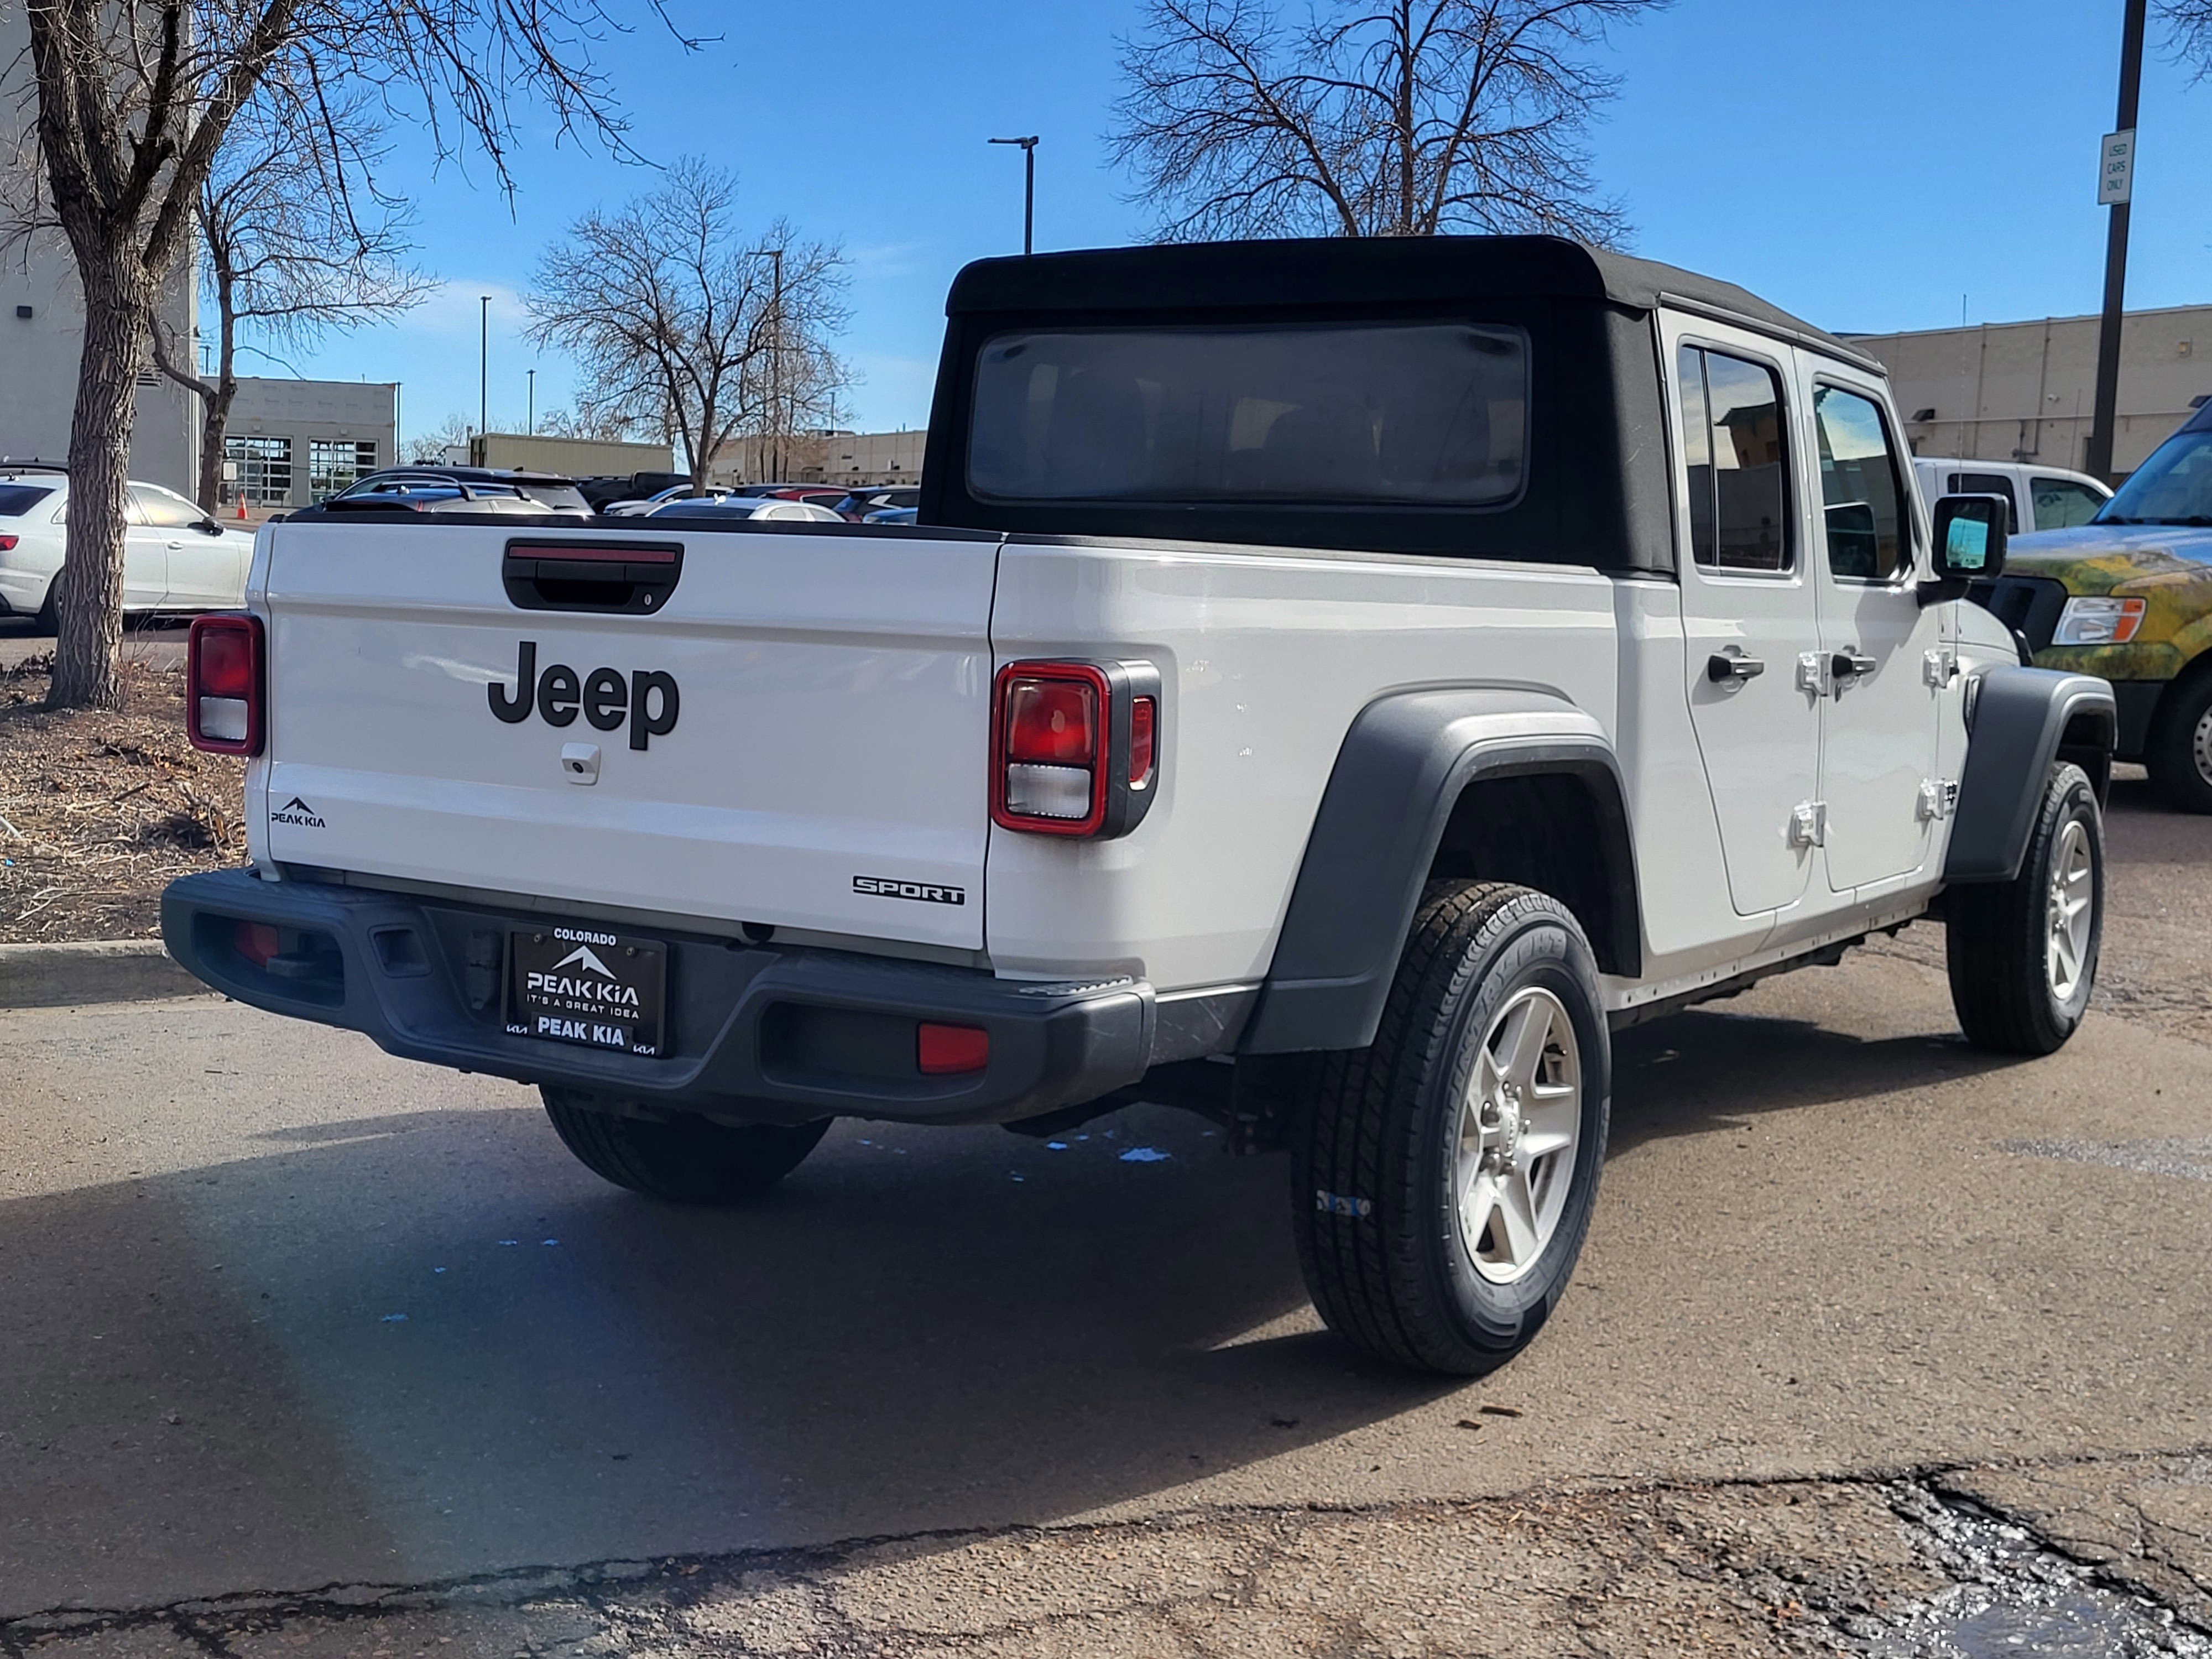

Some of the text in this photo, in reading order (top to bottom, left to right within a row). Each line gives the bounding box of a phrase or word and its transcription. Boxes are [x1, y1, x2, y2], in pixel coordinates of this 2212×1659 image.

[488, 641, 680, 751] Jeep
[272, 812, 326, 828] PEAK KIA
[853, 877, 965, 904] SPORT
[554, 928, 616, 946] COLORADO
[527, 972, 593, 999] PEAK
[526, 994, 639, 1020] IT'S A GREAT IDEA
[538, 1016, 625, 1046] PEAK KIA
